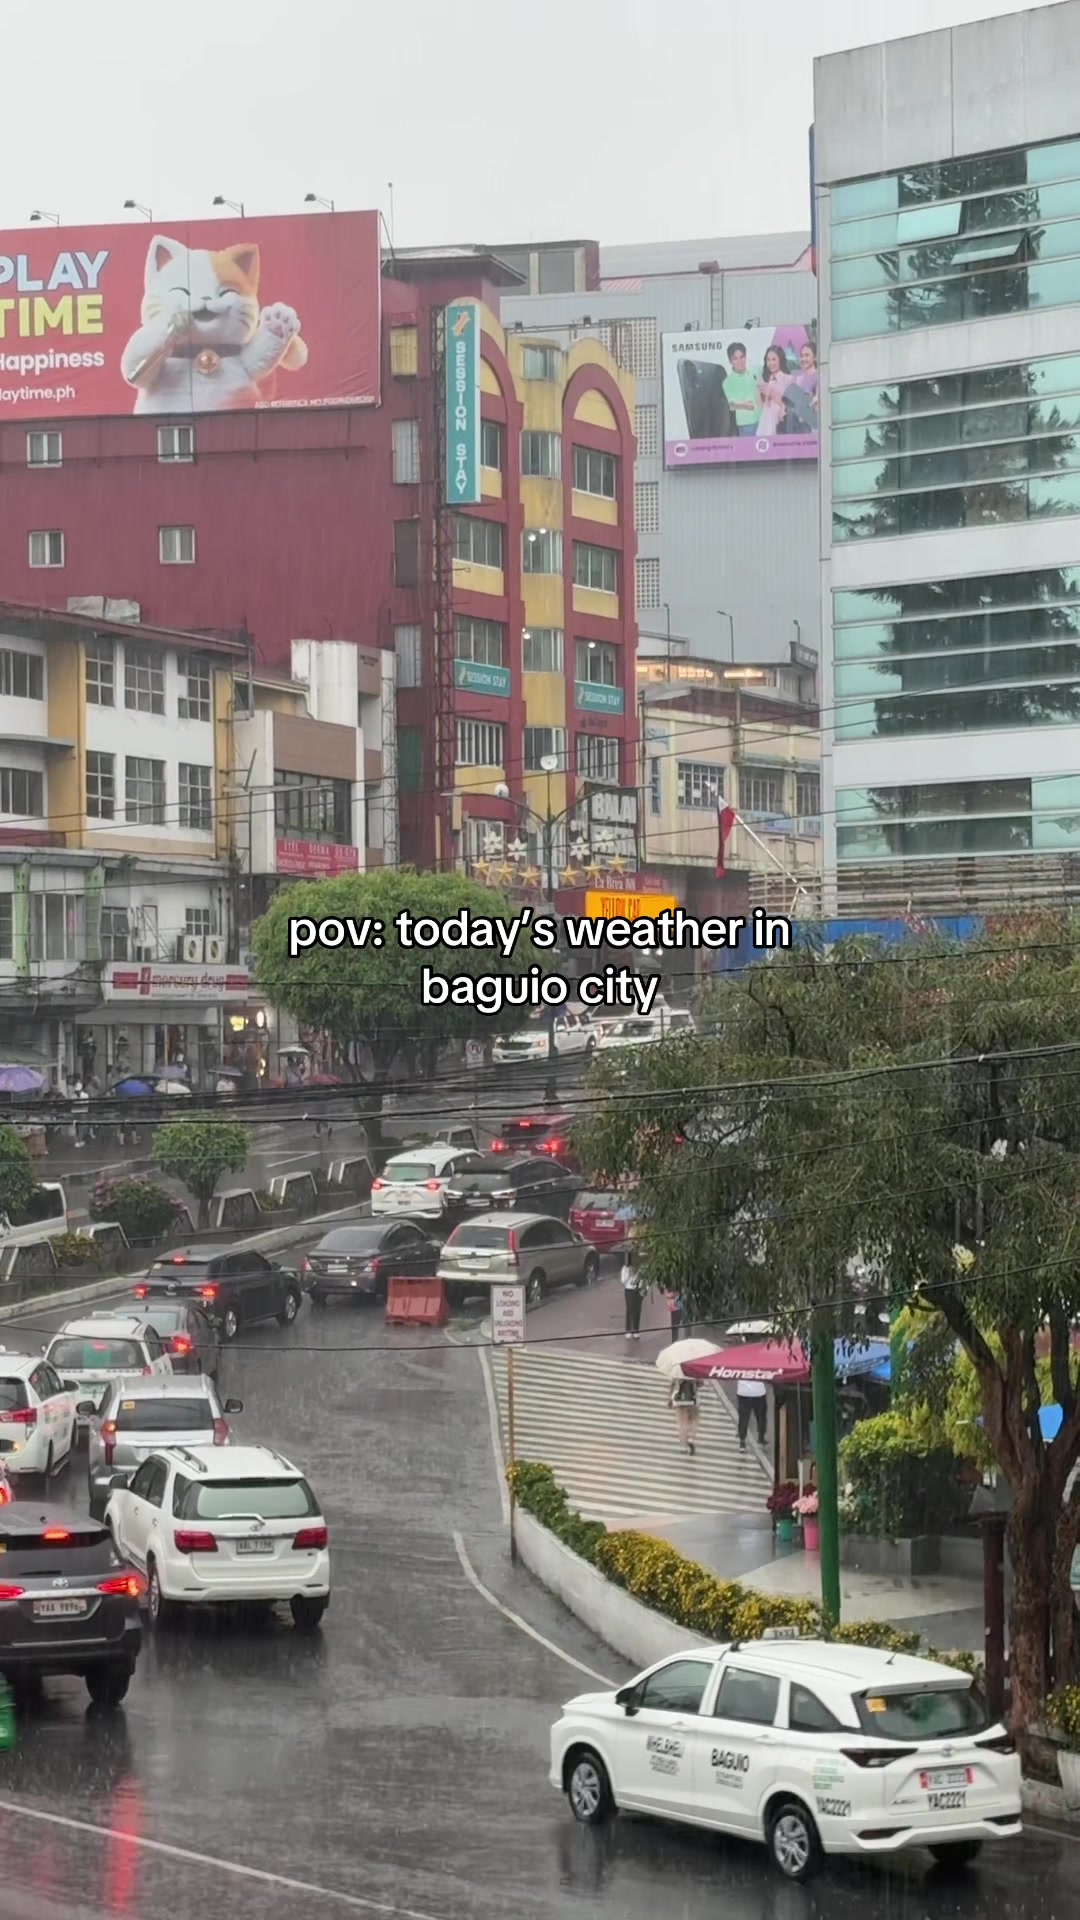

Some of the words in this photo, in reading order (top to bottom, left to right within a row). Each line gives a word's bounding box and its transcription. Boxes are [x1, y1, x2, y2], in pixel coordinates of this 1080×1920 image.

[671, 341, 723, 353] SAMSUNG
[455, 341, 467, 431] SESSION
[455, 443, 467, 494] STAY
[467, 671, 492, 686] SESSION
[492, 675, 507, 688] STAY
[584, 691, 607, 704] SESSION
[607, 694, 620, 706] STAY
[152, 974, 199, 992] mercury
[201, 971, 225, 992] drug
[502, 1290, 514, 1298] NO
[496, 1299, 520, 1307] LOADING
[708, 1365, 781, 1380] Homstar
[711, 1747, 750, 1773] BAGUIO
[927, 1791, 967, 1812] YAC2221
